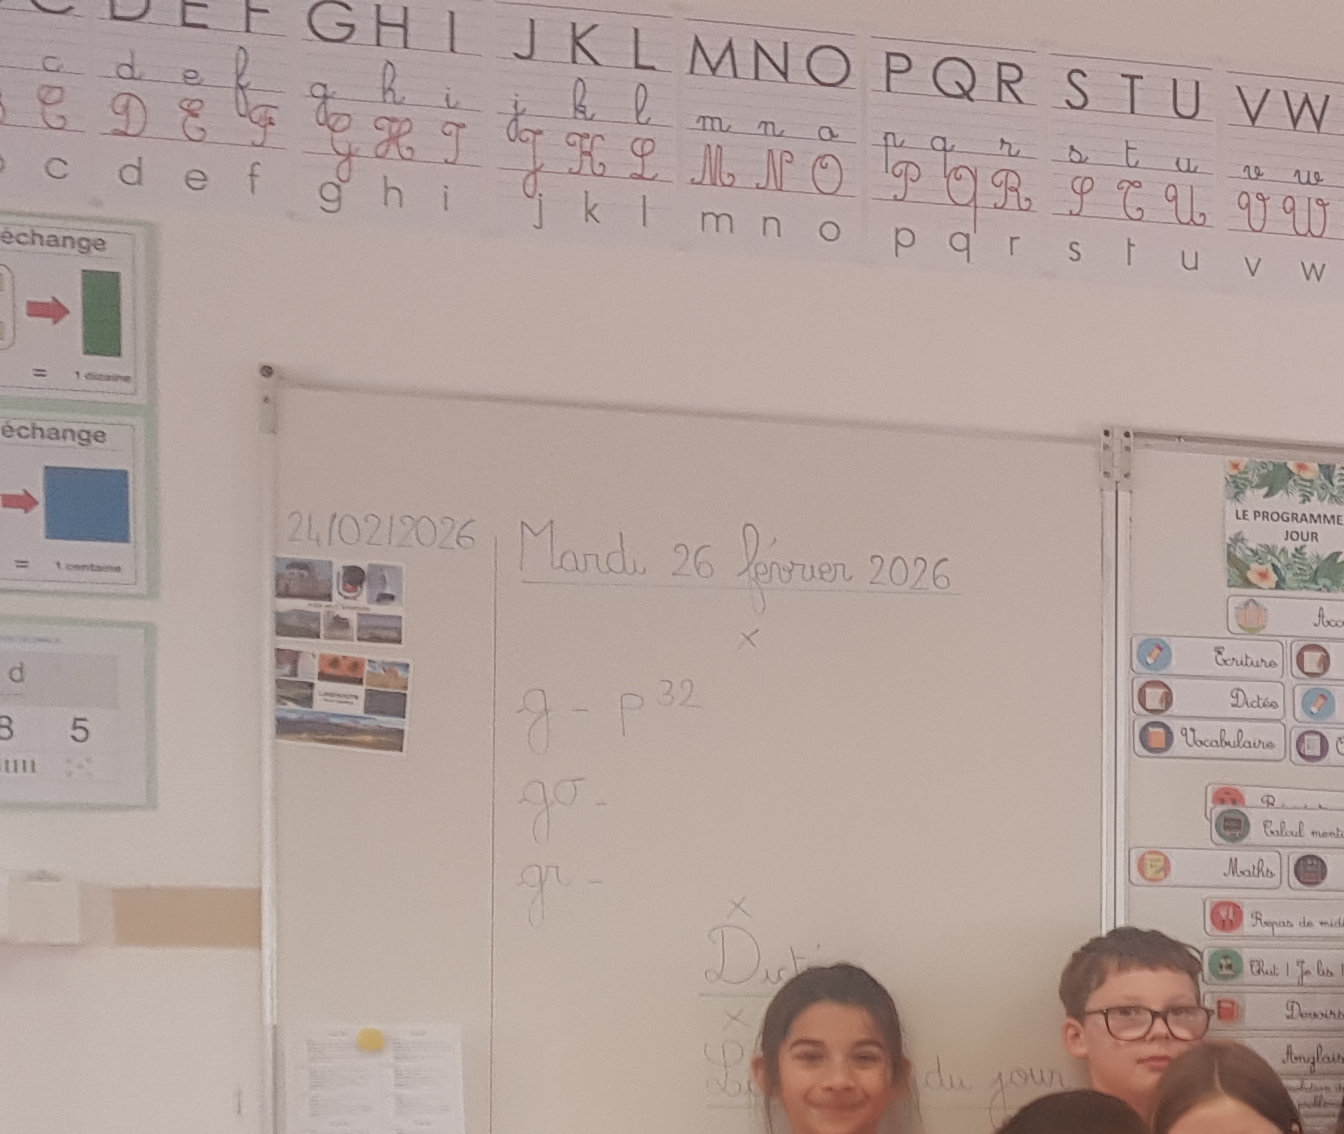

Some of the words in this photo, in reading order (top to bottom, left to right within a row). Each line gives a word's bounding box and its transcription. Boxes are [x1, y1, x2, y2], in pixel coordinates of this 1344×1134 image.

[308, 1, 356, 43] G
[375, 5, 409, 49] H
[513, 18, 536, 60] J
[571, 23, 600, 65] K
[634, 28, 655, 69] L
[690, 35, 738, 79] M
[753, 39, 789, 82] N
[806, 45, 850, 87] O
[885, 52, 912, 92] P
[932, 57, 976, 103] Q
[997, 61, 1025, 104] R
[1065, 68, 1089, 110] S
[1120, 74, 1144, 114] T
[1172, 78, 1200, 119] U
[1235, 85, 1270, 126] V
[1283, 90, 1330, 133] W
[44, 157, 68, 180] c
[118, 156, 143, 186] d
[184, 169, 208, 191] e
[248, 161, 261, 194] f
[319, 180, 342, 213] g
[382, 176, 402, 208] h
[442, 184, 449, 212] i
[531, 192, 544, 230] j
[583, 189, 600, 224] k
[701, 210, 733, 234] m
[762, 214, 781, 237] n
[819, 220, 841, 242] o
[894, 226, 916, 257] p
[948, 230, 971, 263] q
[1009, 235, 1021, 256] r
[1068, 241, 1082, 263] s
[1126, 237, 1136, 266] t
[1181, 249, 1199, 272] u
[1244, 256, 1262, 277] v
[1300, 260, 1327, 283] w
[1235, 508, 1250, 522] LE
[1253, 510, 1344, 528] PROGRAMME
[1284, 530, 1320, 544] JOUR
[519, 519, 647, 577] Mardi
[672, 544, 715, 579] 26
[736, 522, 852, 615] février
[869, 554, 951, 591] 2026
[657, 679, 702, 708] 32
[1230, 687, 1280, 710] Dictée
[70, 717, 90, 743] 5
[1180, 726, 1276, 751] Vocabulaire
[1262, 819, 1305, 839] Calcul
[1223, 858, 1276, 879] Maths
[1250, 911, 1294, 937] Repas
[923, 1055, 974, 1092] du
